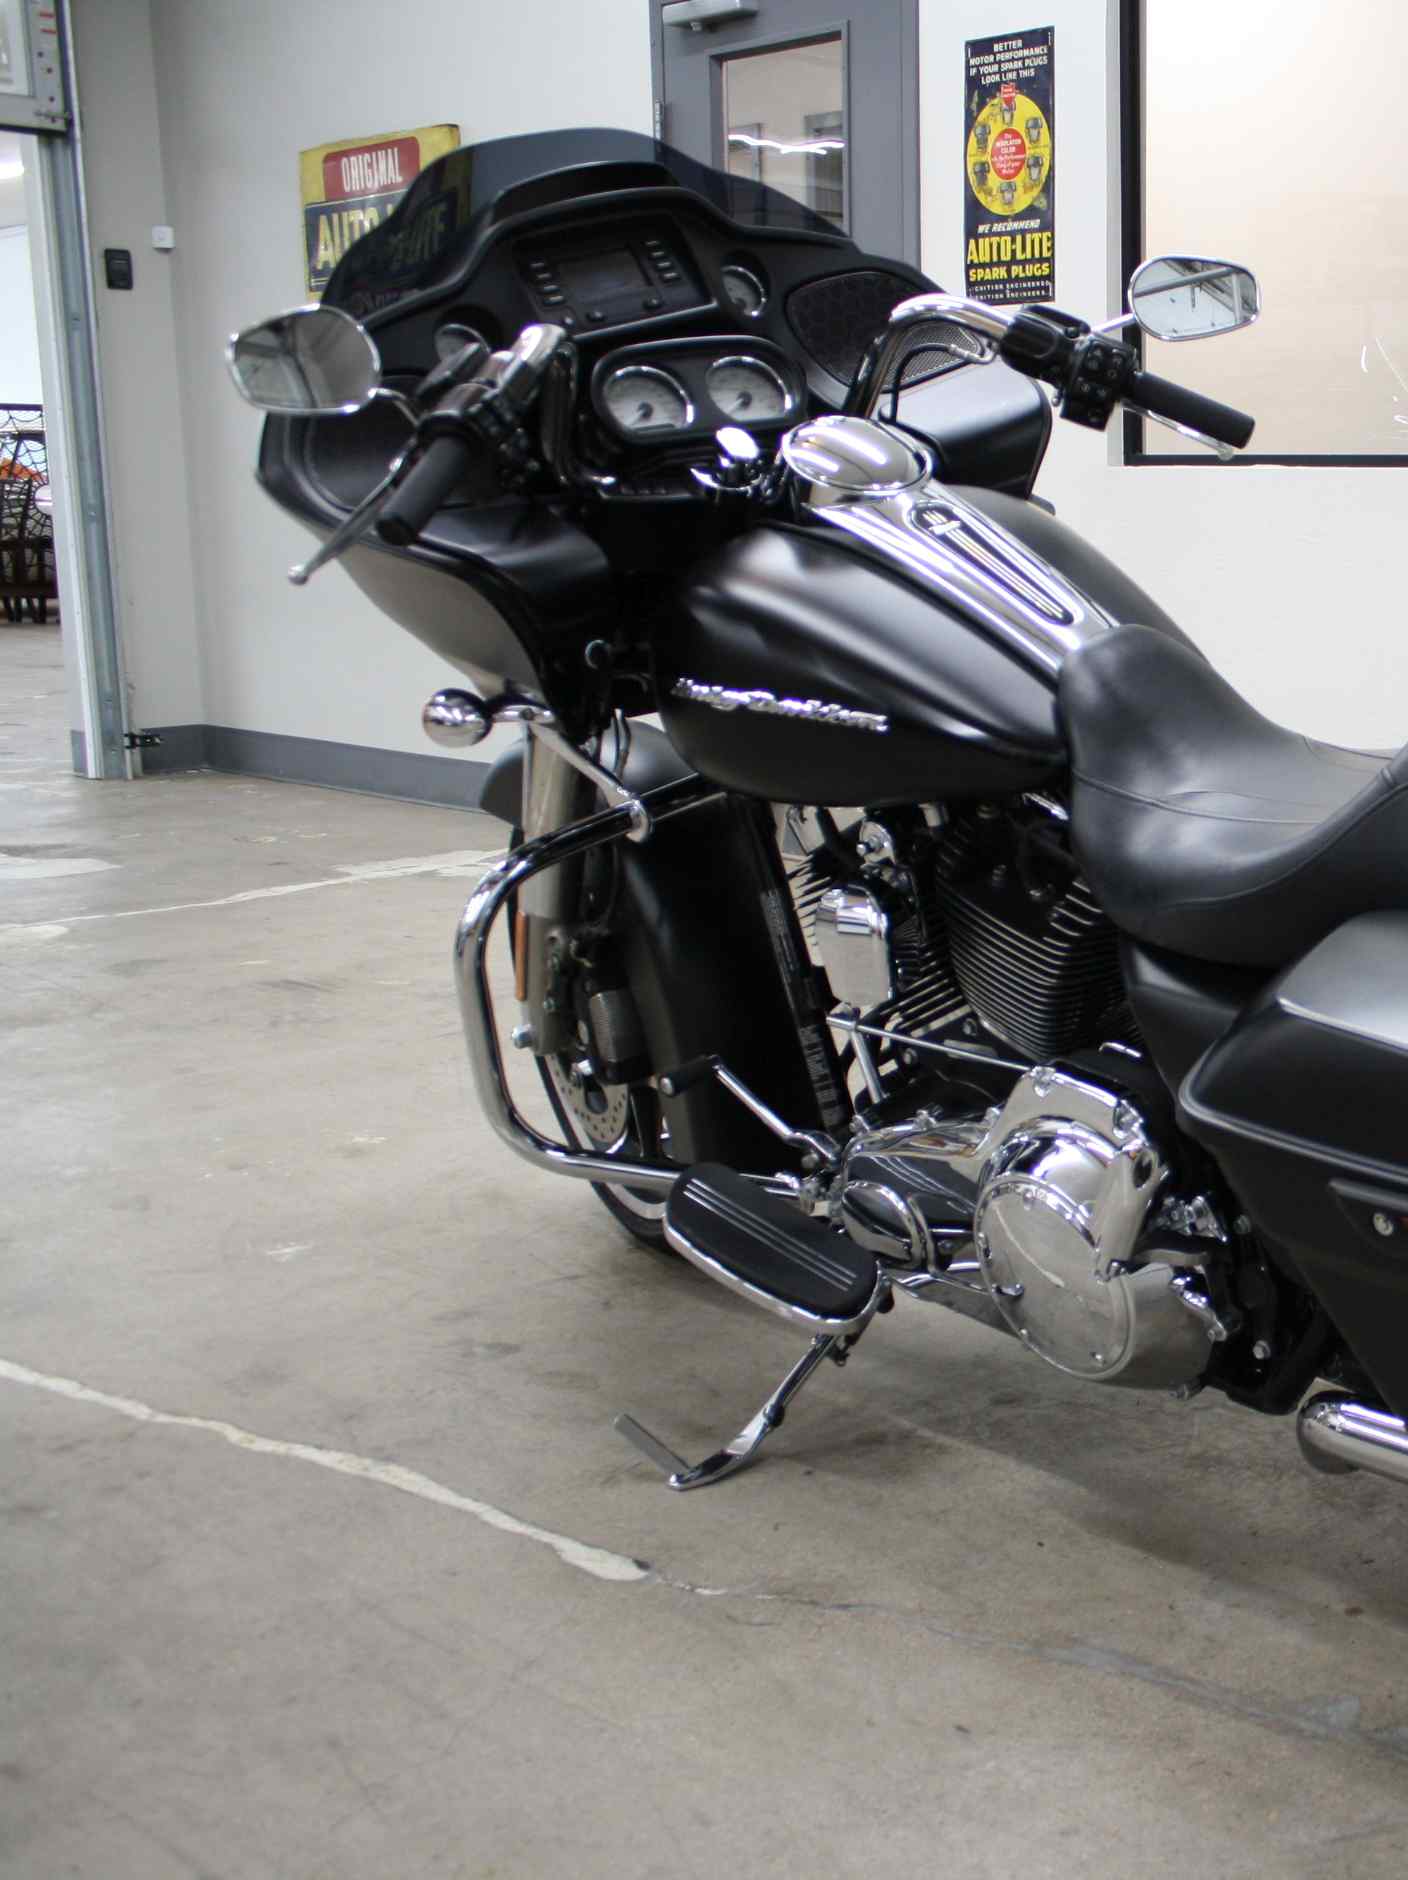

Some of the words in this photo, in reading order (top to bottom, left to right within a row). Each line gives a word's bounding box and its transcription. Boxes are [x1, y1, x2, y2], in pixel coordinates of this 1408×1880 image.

[969, 54, 994, 66] MOTOR
[995, 45, 1048, 61] PERFORMANCE
[993, 39, 1023, 52] BETTER
[969, 66, 977, 76] IF
[978, 63, 999, 74] YOUR
[1000, 60, 1023, 72] SPARK
[1024, 55, 1048, 67] PLUGS
[981, 74, 1001, 85] LOOK
[1001, 71, 1018, 81] LIKE
[1018, 68, 1035, 78] THIS
[341, 147, 403, 193] ORIGINAL
[977, 223, 992, 234] WE
[991, 218, 1041, 232] RECOMMEND
[967, 231, 1052, 264] AUTO-LITE
[968, 265, 1008, 282] SPARK
[1010, 262, 1050, 278] PLUGS
